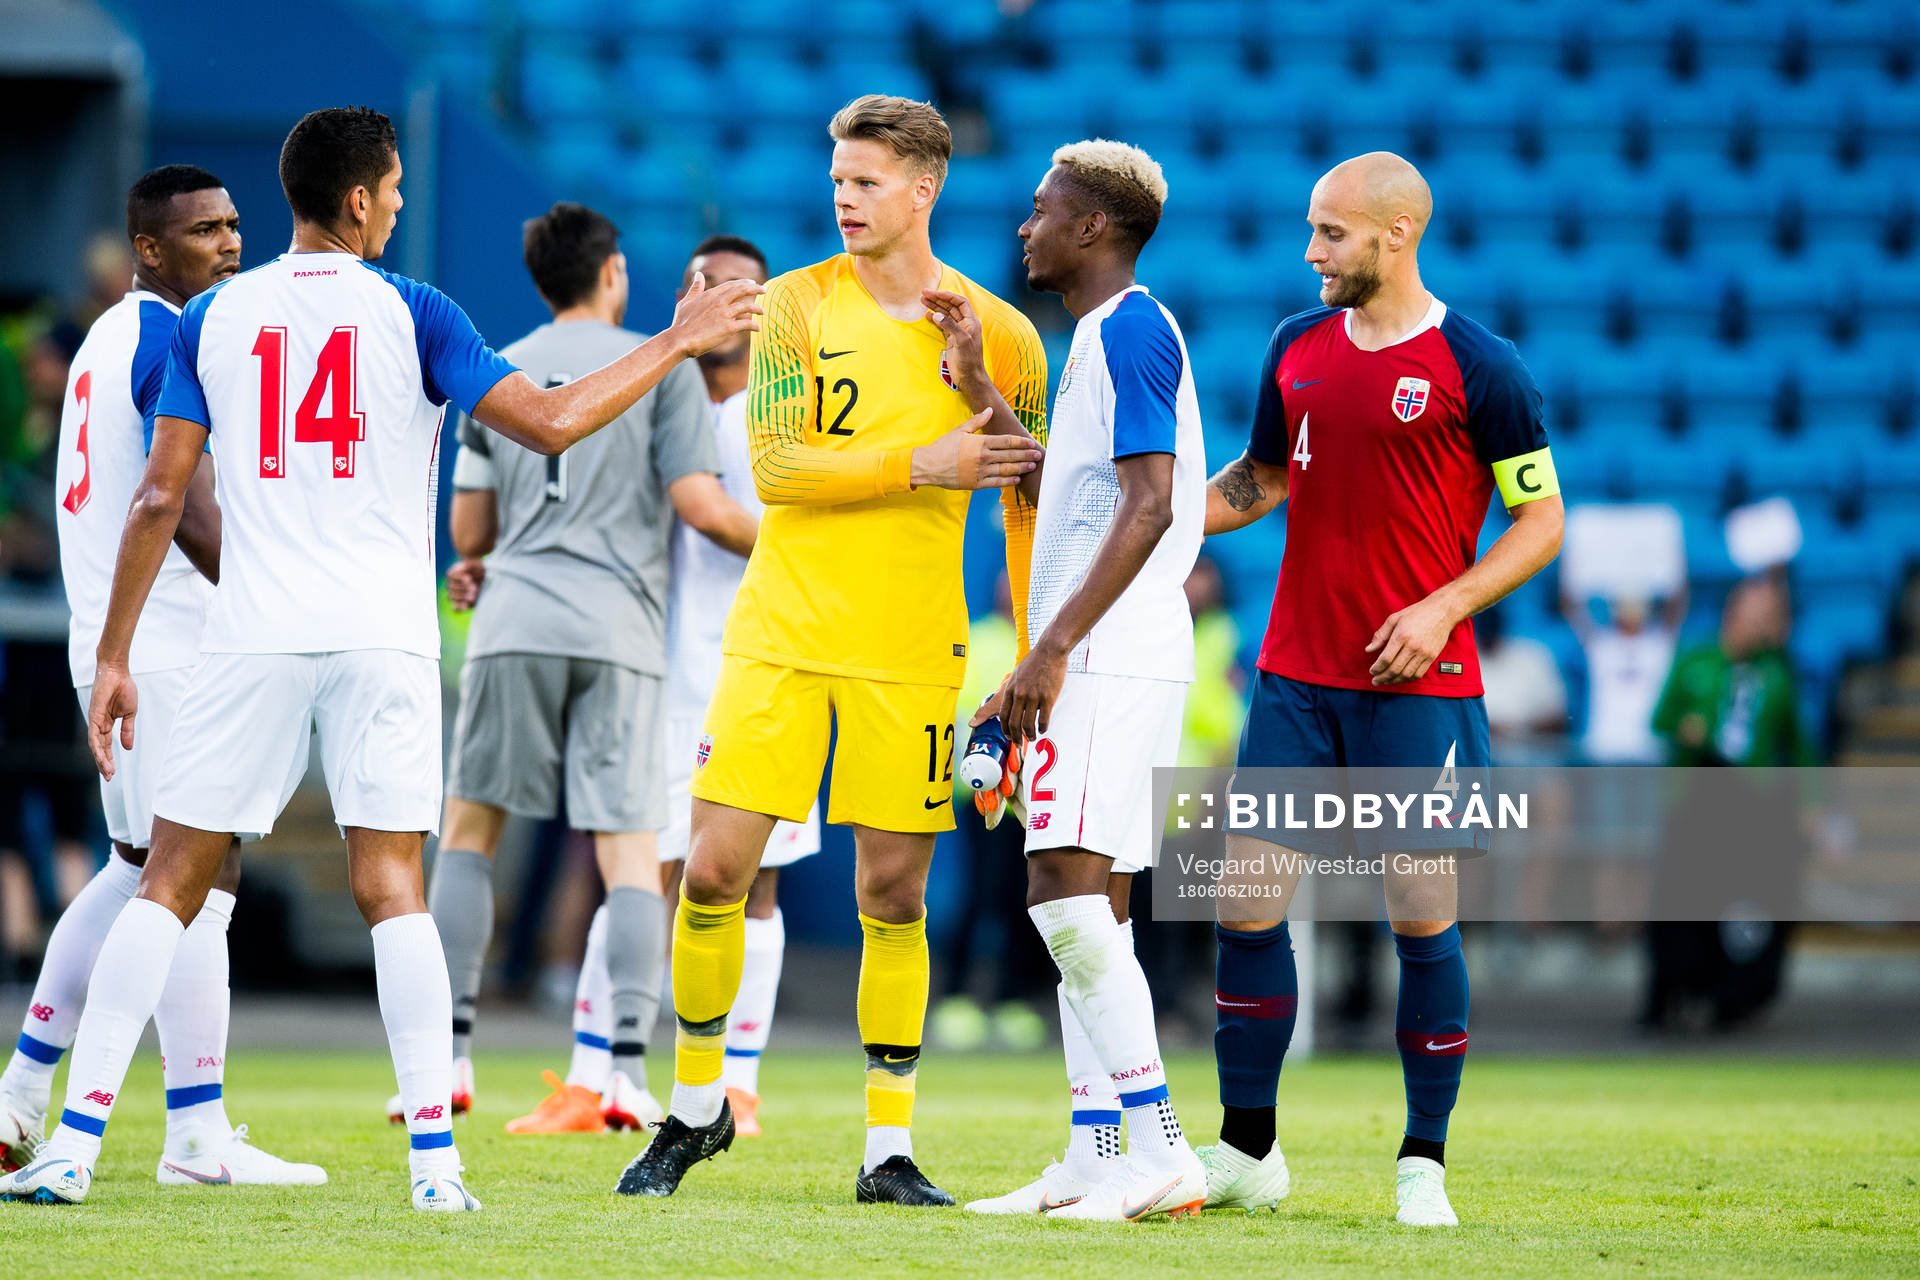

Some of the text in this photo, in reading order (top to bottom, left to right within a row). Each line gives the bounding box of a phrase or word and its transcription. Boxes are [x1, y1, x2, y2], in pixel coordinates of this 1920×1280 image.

[250, 325, 366, 479] 14
[815, 375, 859, 437] 12
[62, 369, 92, 517] 3
[1292, 410, 1313, 471] 4
[1516, 463, 1543, 493] C
[924, 723, 955, 783] 12
[1030, 737, 1059, 802] 2
[1432, 739, 1460, 800] 4
